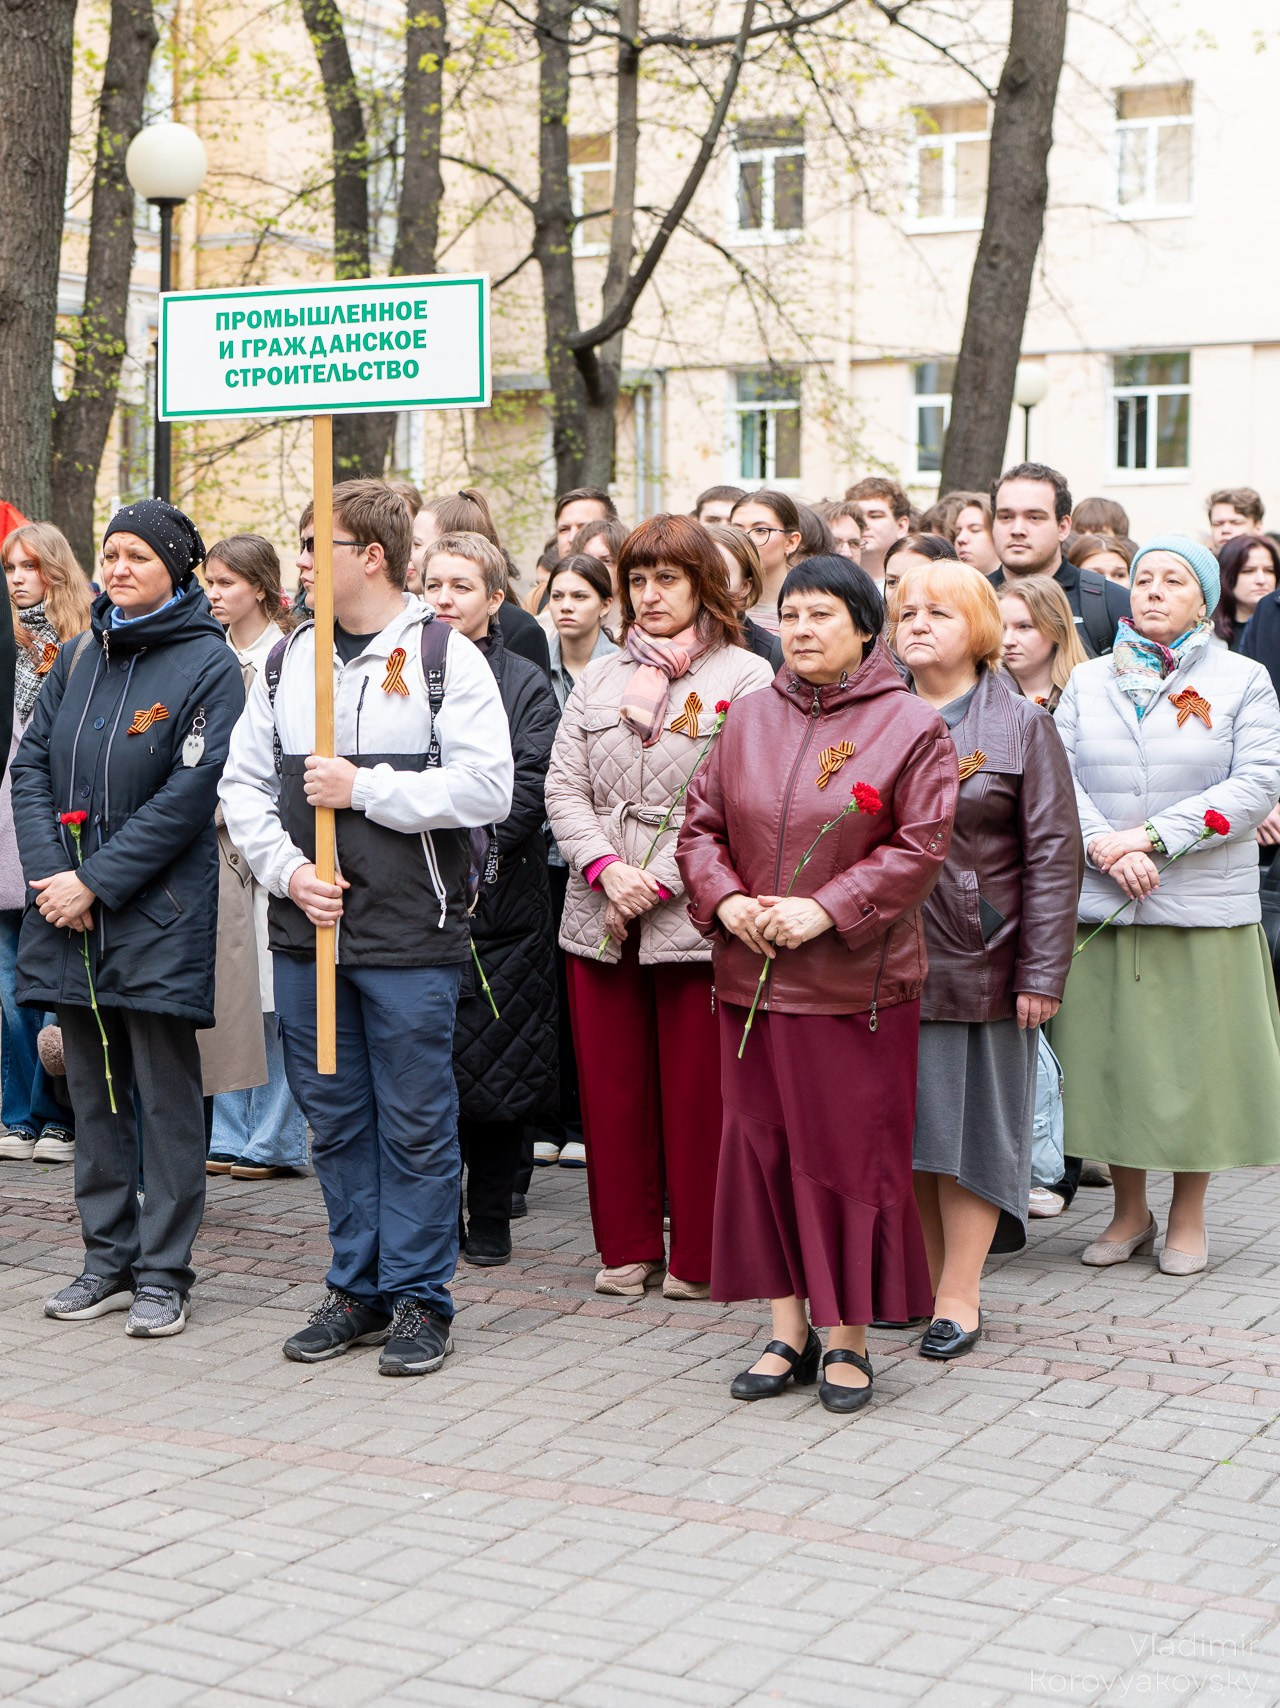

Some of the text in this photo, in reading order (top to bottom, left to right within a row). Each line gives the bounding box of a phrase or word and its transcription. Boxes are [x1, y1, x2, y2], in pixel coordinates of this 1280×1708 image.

[216, 300, 428, 331] ПРОМЫШЛЕННОЕ
[219, 329, 427, 360] И ГРАЖДАНСКОЕ
[225, 359, 420, 388] СТРОИТЕЛЬСТВО
